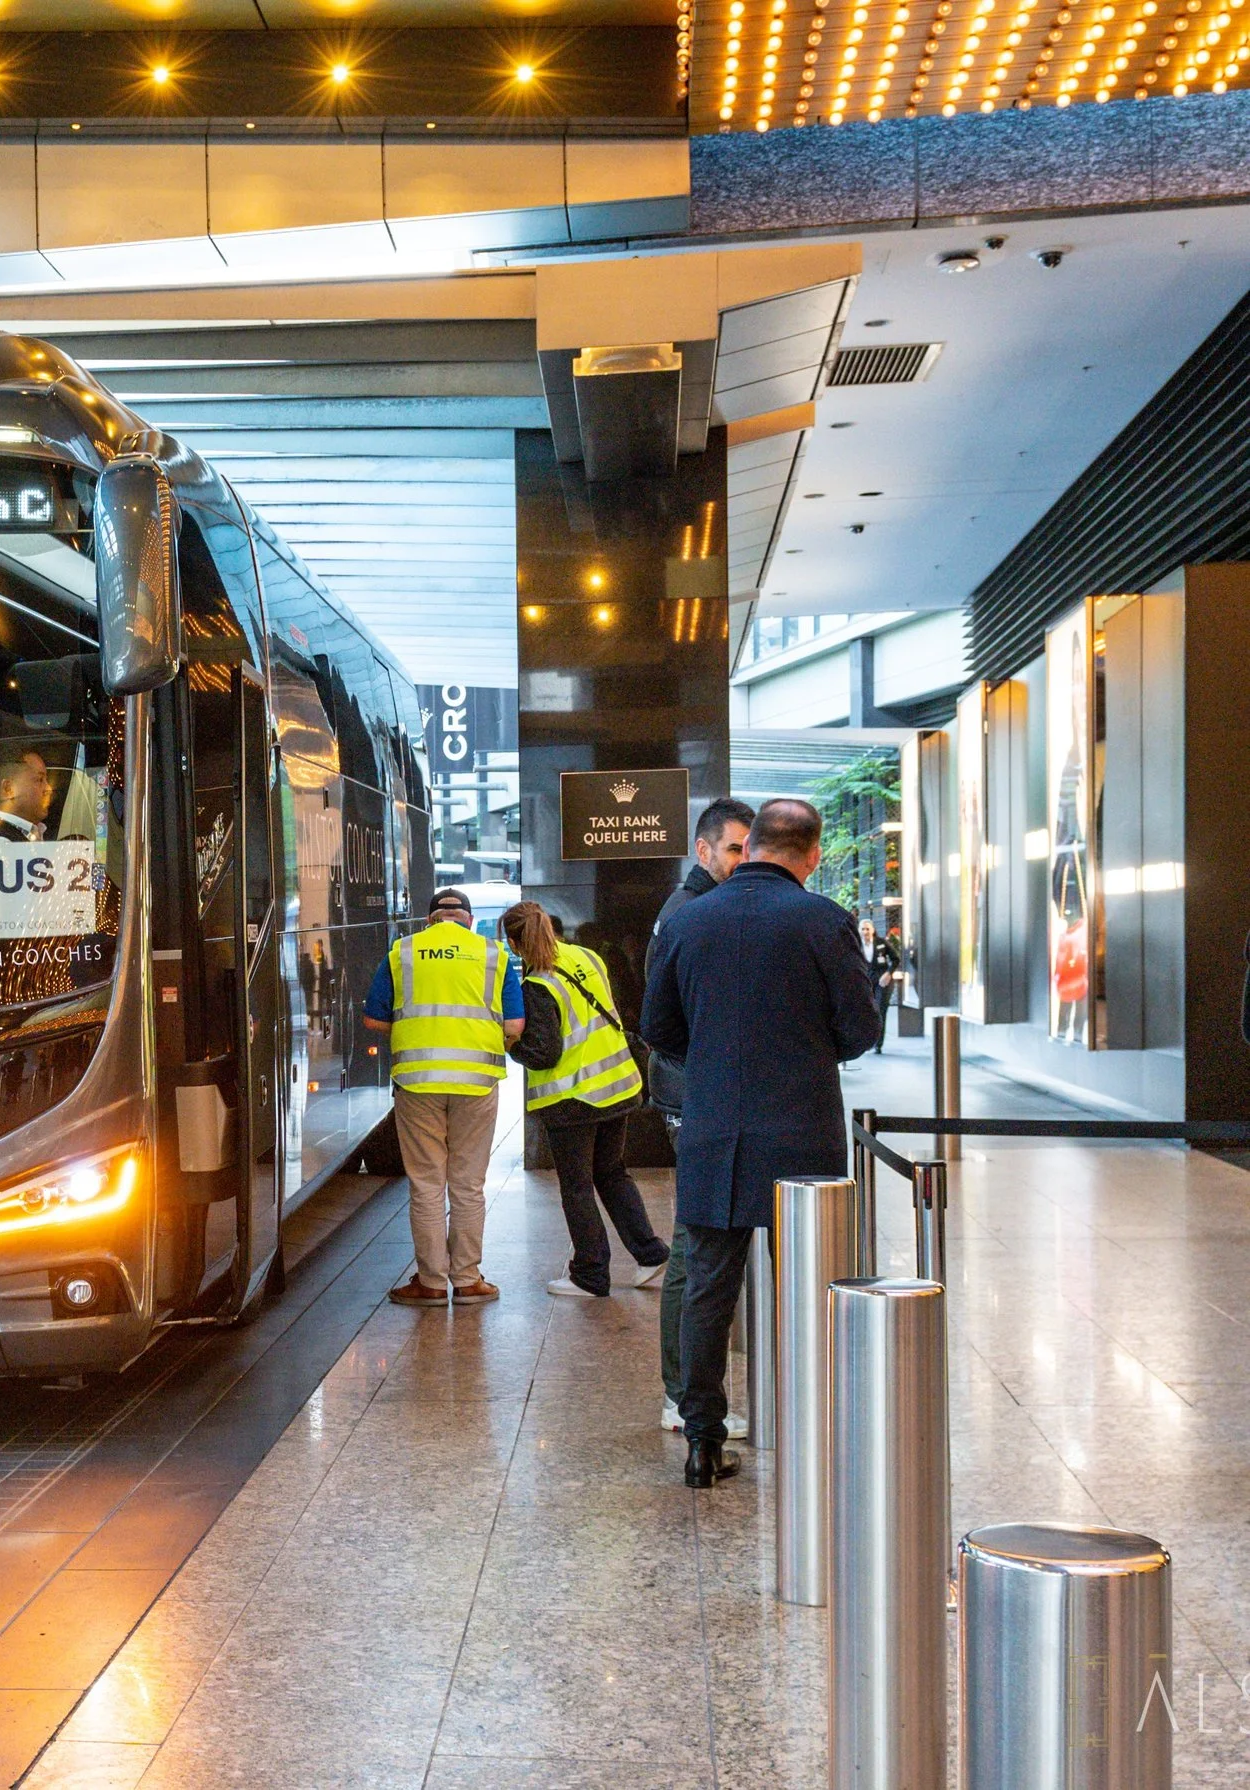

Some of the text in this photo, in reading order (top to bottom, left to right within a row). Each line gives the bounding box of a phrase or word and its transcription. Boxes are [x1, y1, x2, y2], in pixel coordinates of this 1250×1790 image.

[588, 815, 661, 828] TAXI RANK
[583, 830, 667, 846] QUEUE HERE
[67, 857, 91, 892] 2
[417, 948, 455, 960] TMS
